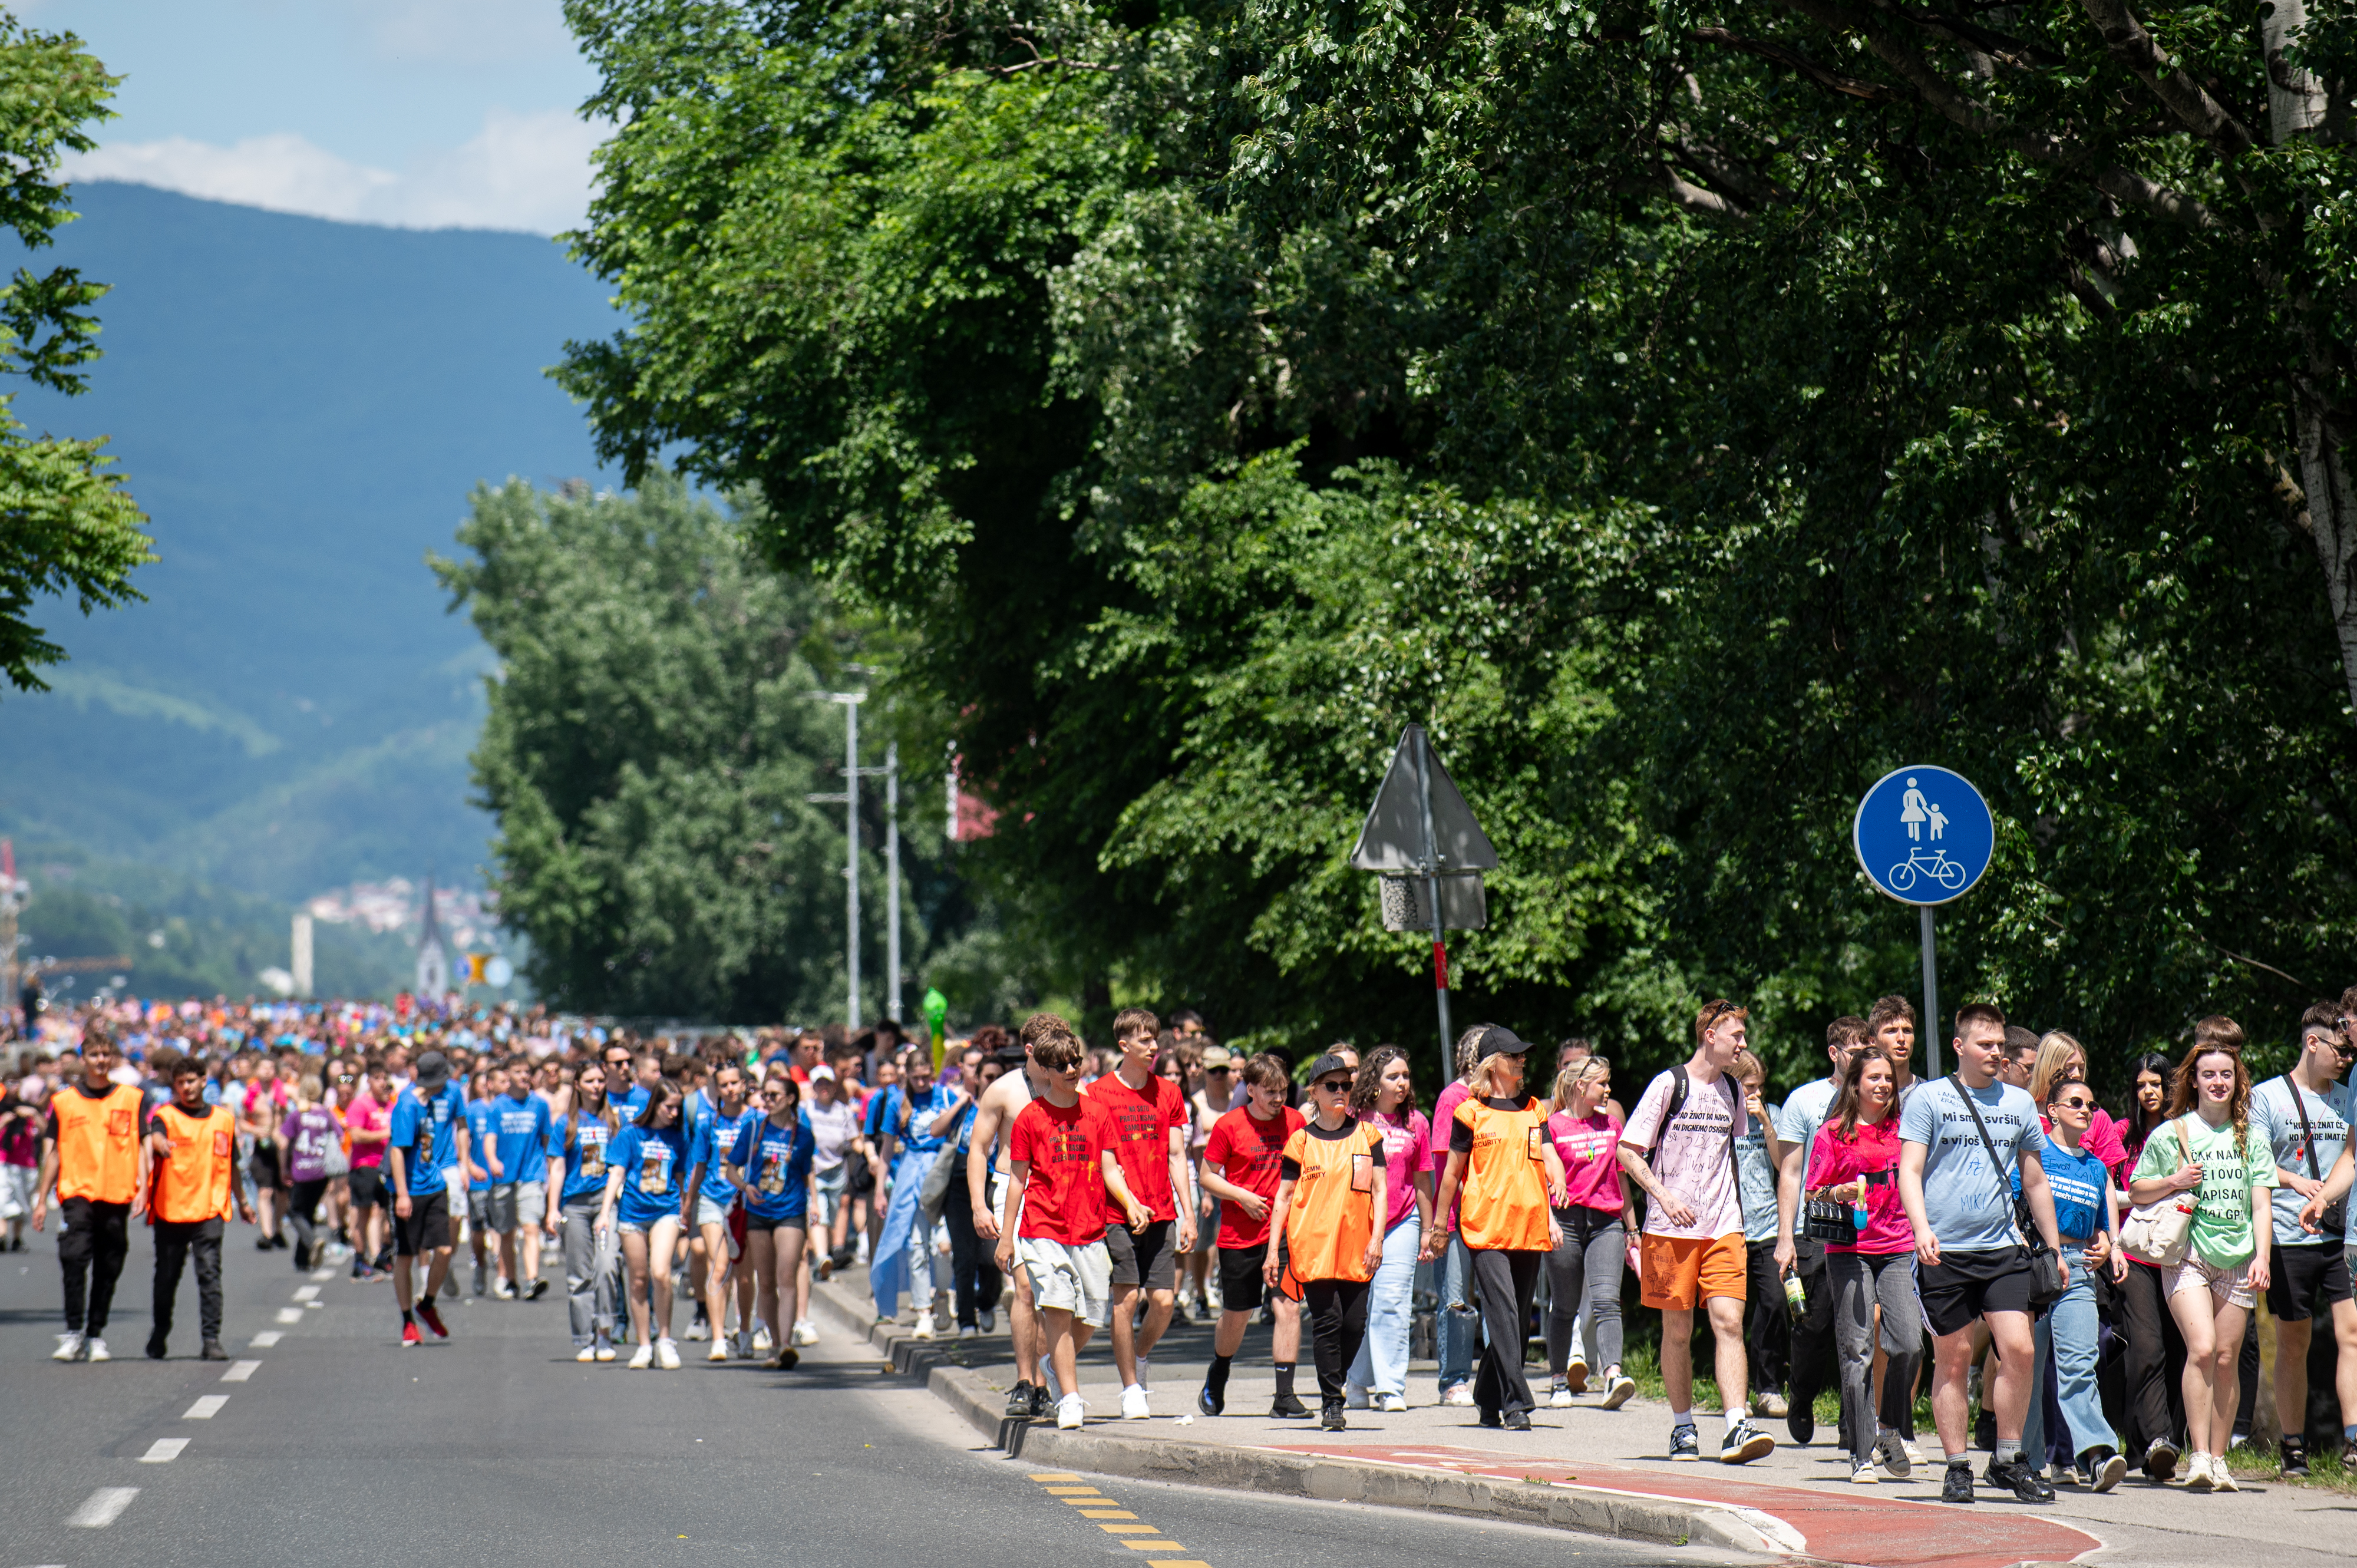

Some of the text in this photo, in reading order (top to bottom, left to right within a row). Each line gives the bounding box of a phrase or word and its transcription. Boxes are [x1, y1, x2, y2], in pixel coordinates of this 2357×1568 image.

[1689, 1110, 1706, 1120] ŽIVOT
[1943, 1112, 2022, 1128] Mi sm svršili,
[1124, 1124, 1140, 1132] SAMO
[1681, 1124, 1708, 1133] DIGNEMO
[2318, 1121, 2335, 1130] ZNAT
[1474, 1131, 1497, 1141] KLEMM
[1942, 1137, 1949, 1145] a
[1951, 1134, 1962, 1145] vi
[1964, 1135, 1980, 1147] još
[2289, 1133, 2299, 1141] KO
[2300, 1133, 2323, 1141] KADE
[2325, 1133, 2341, 1141] IMAT
[1054, 1143, 1068, 1153] SA
[1474, 1138, 1502, 1148] ECURITY
[2191, 1148, 2243, 1162] ČAK NAM
[1302, 1165, 1321, 1175] KEMM
[2201, 1168, 2243, 1180] E I OVO
[1302, 1171, 1326, 1182] ECURITY
[2193, 1189, 2244, 1201] NAPISAO
[1960, 1191, 1987, 1212] MIKI
[2197, 1204, 2223, 1219] HAT
